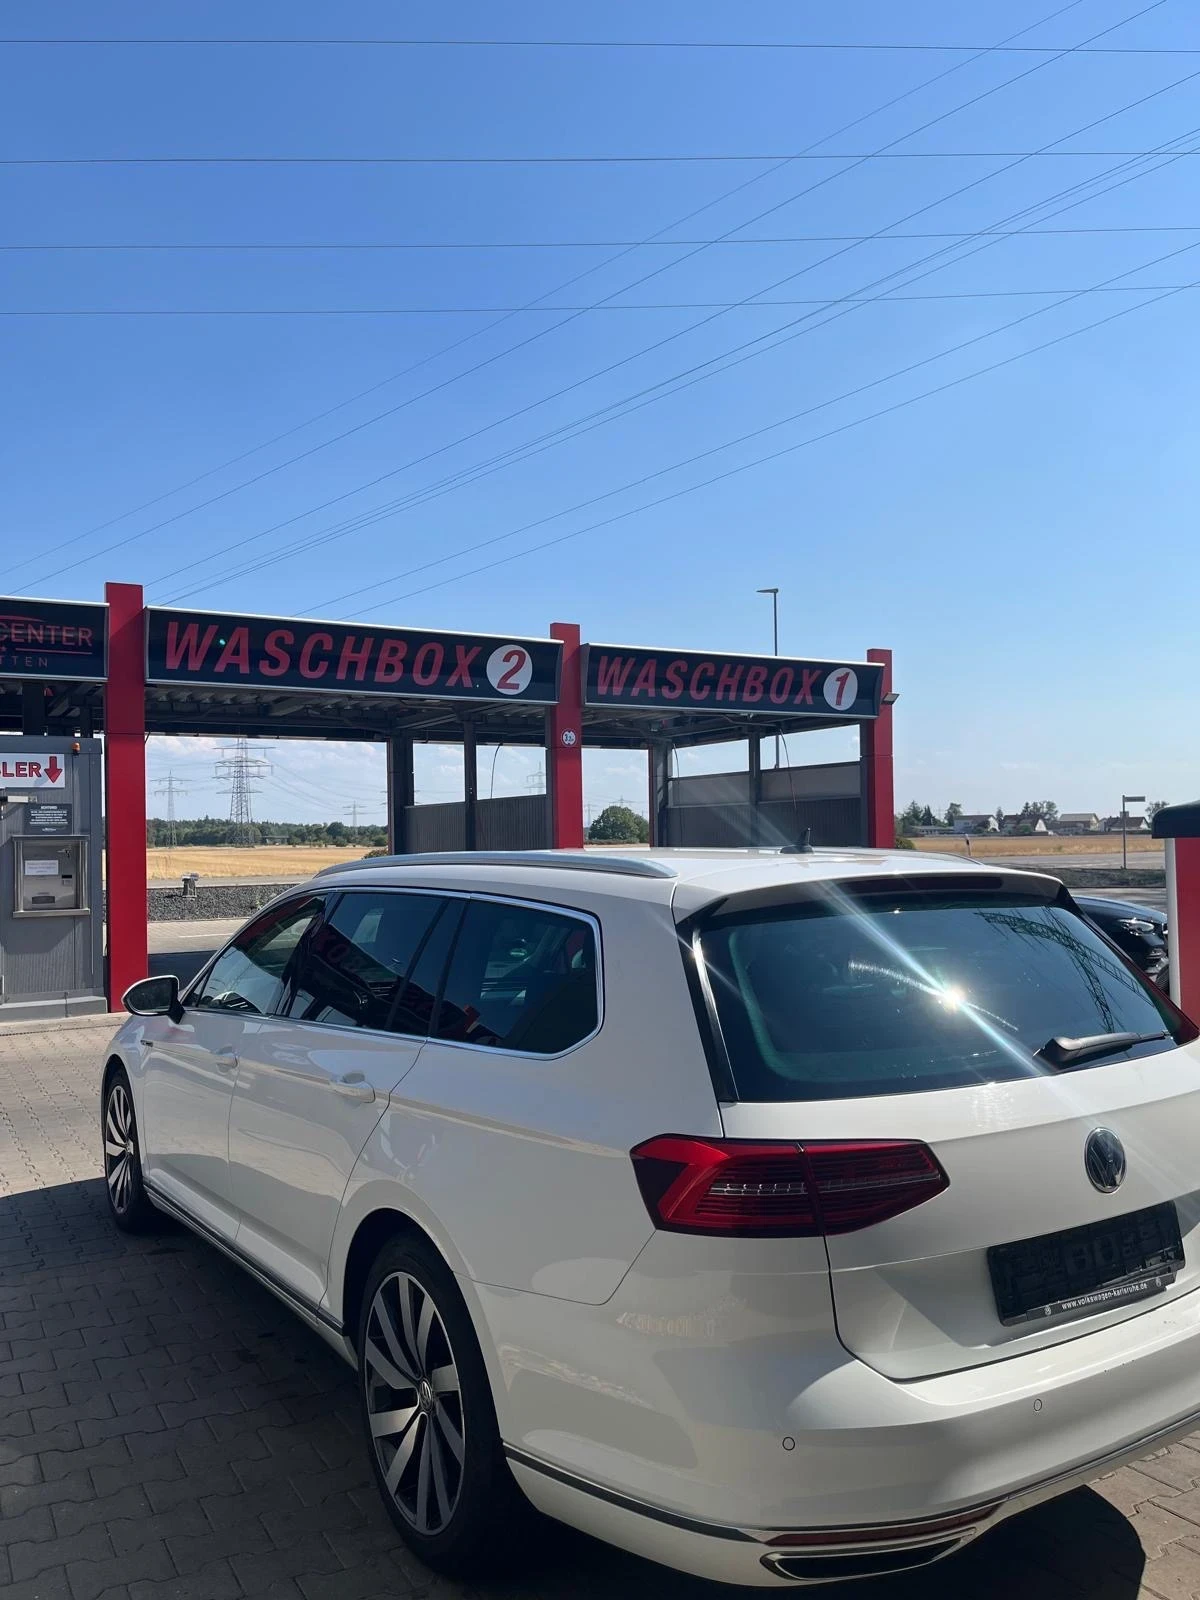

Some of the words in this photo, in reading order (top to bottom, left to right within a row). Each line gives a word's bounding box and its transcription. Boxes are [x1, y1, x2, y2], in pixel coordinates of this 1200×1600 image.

[164, 621, 482, 689] WASCHBOX
[496, 649, 527, 690] 2
[597, 655, 822, 706] WASCHBOX
[834, 671, 851, 706] 1
[0, 761, 42, 778] LER
[1061, 1283, 1148, 1310] www.volkswagen-karlsruhe.de
